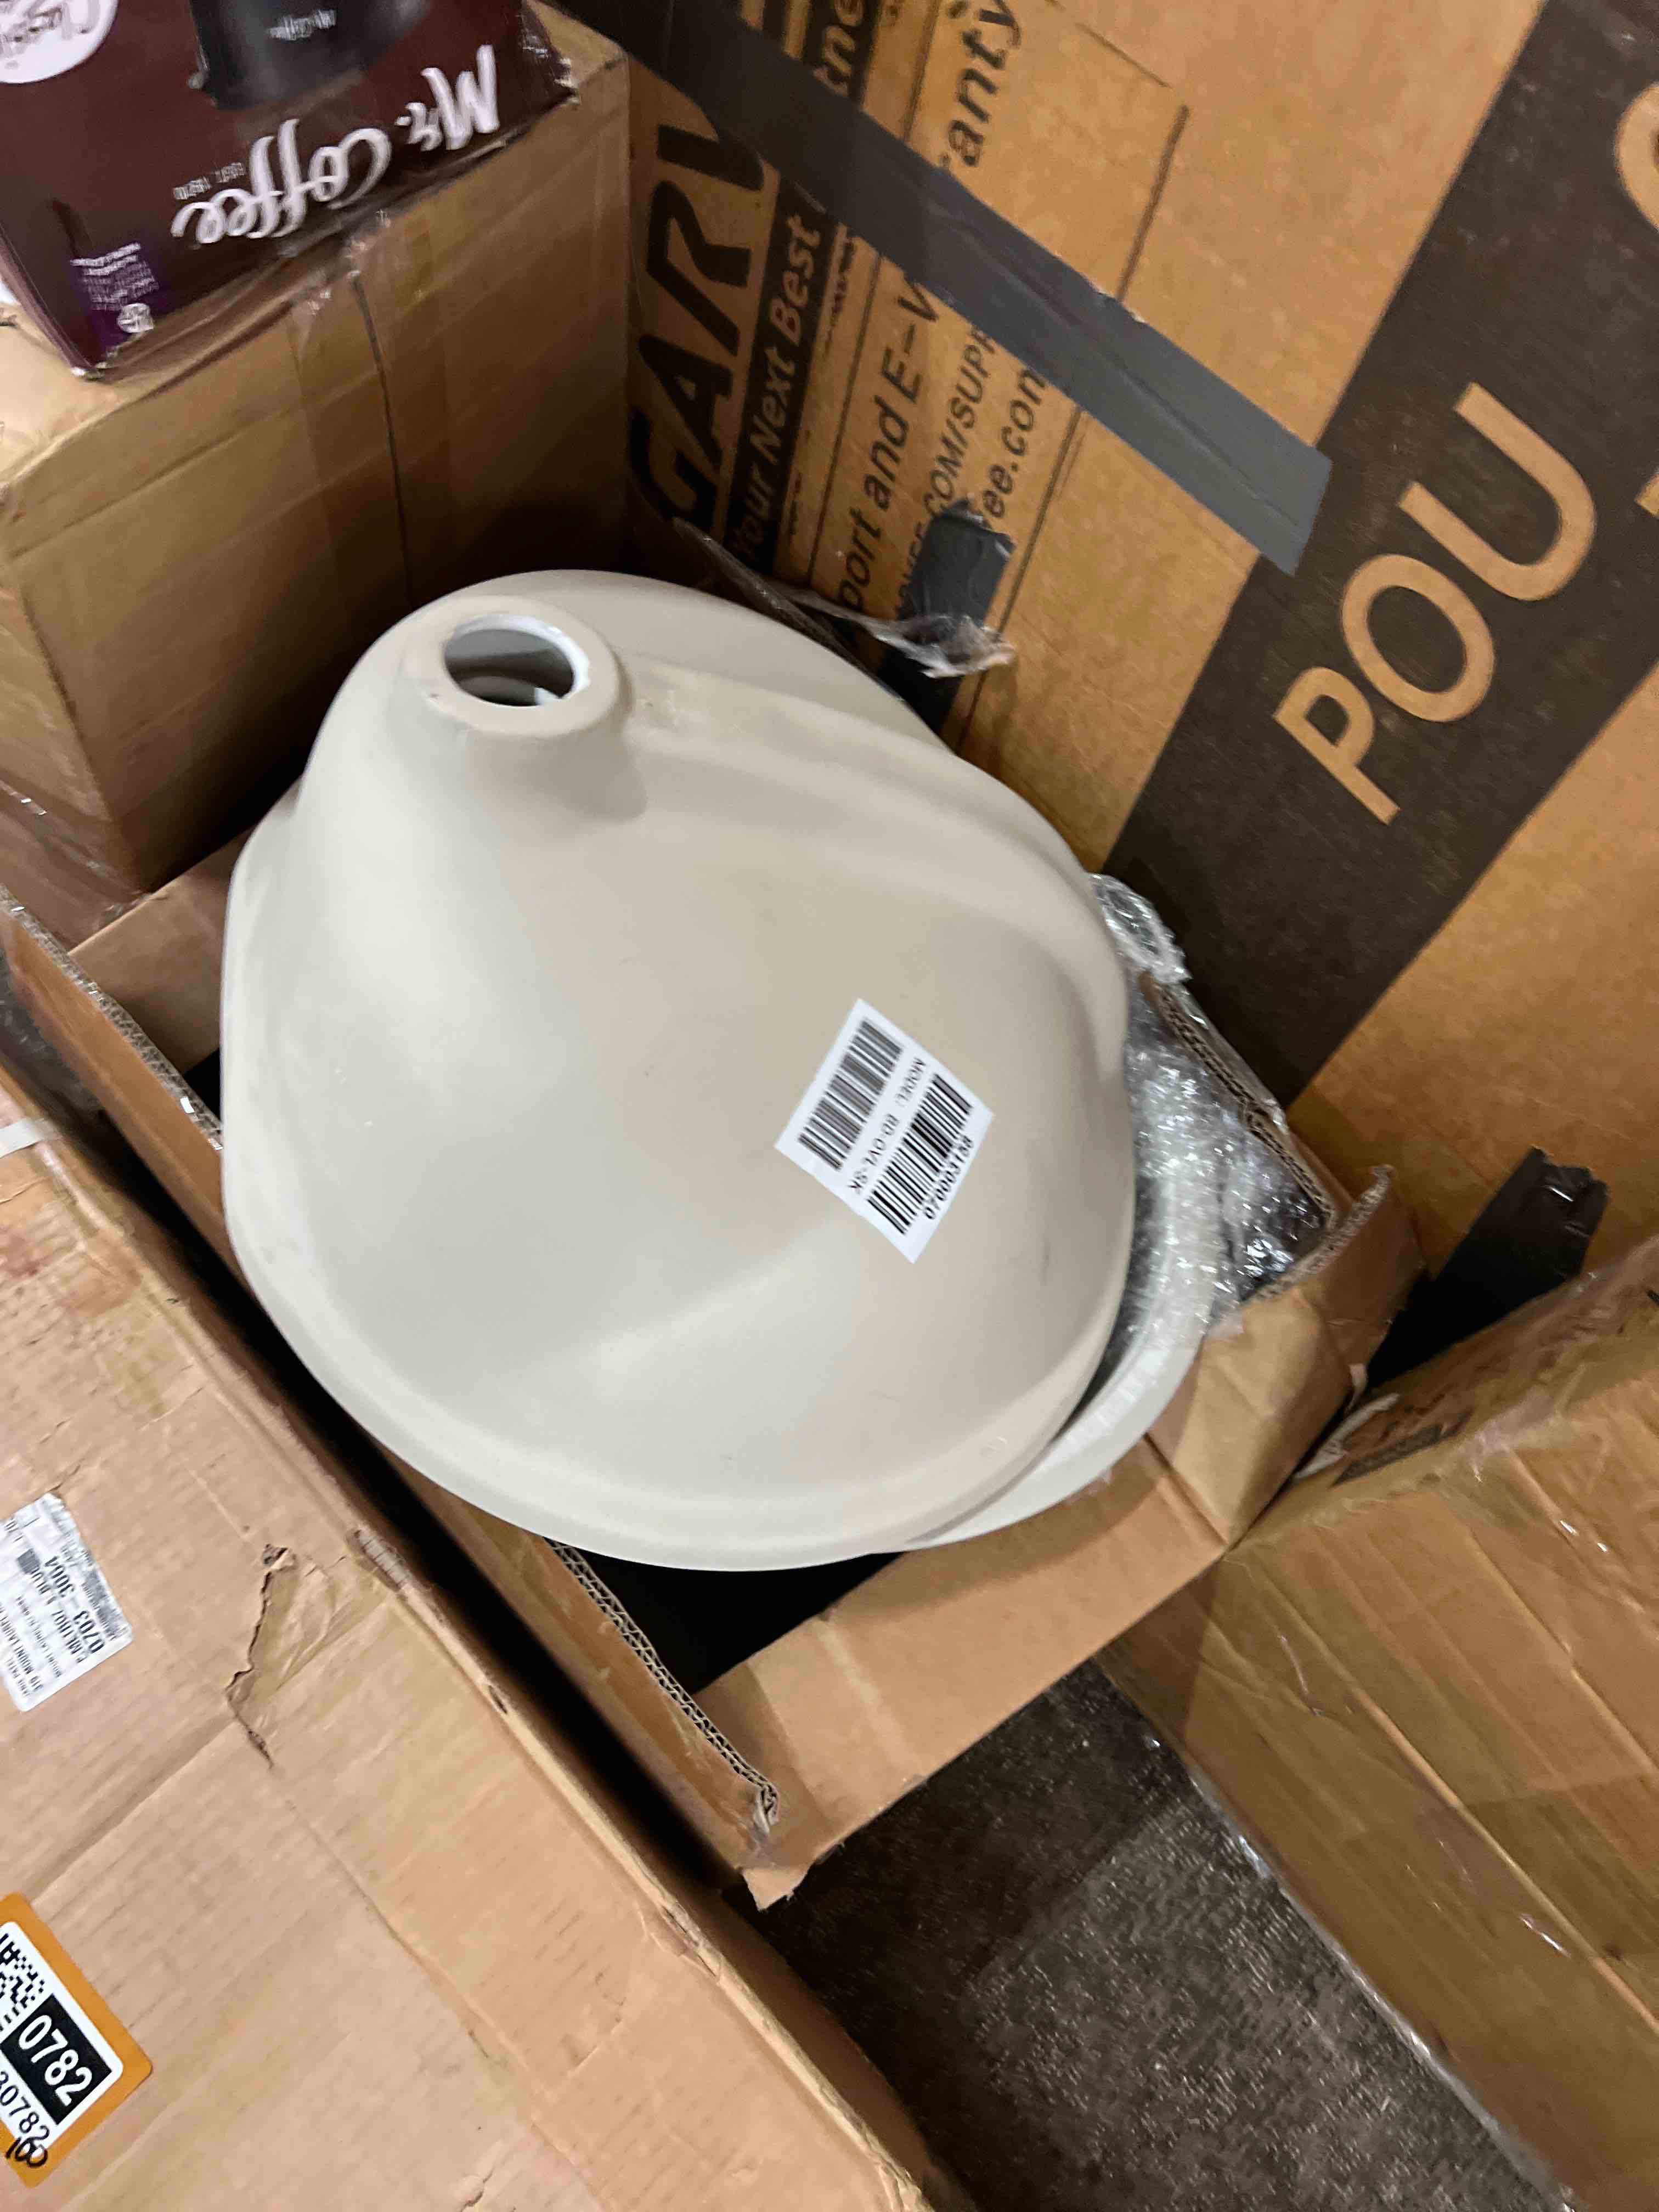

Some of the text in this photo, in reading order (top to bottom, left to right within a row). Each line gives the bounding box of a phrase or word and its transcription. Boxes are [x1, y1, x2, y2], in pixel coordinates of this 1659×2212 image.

[171, 44, 500, 244] Mr. Coffee
[768, 214, 821, 346] Best
[749, 346, 796, 466] Next
[838, 506, 882, 611] port
[863, 394, 910, 513] and
[74, 1610, 105, 1655] 0703
[19, 2015, 92, 2107] 0782
